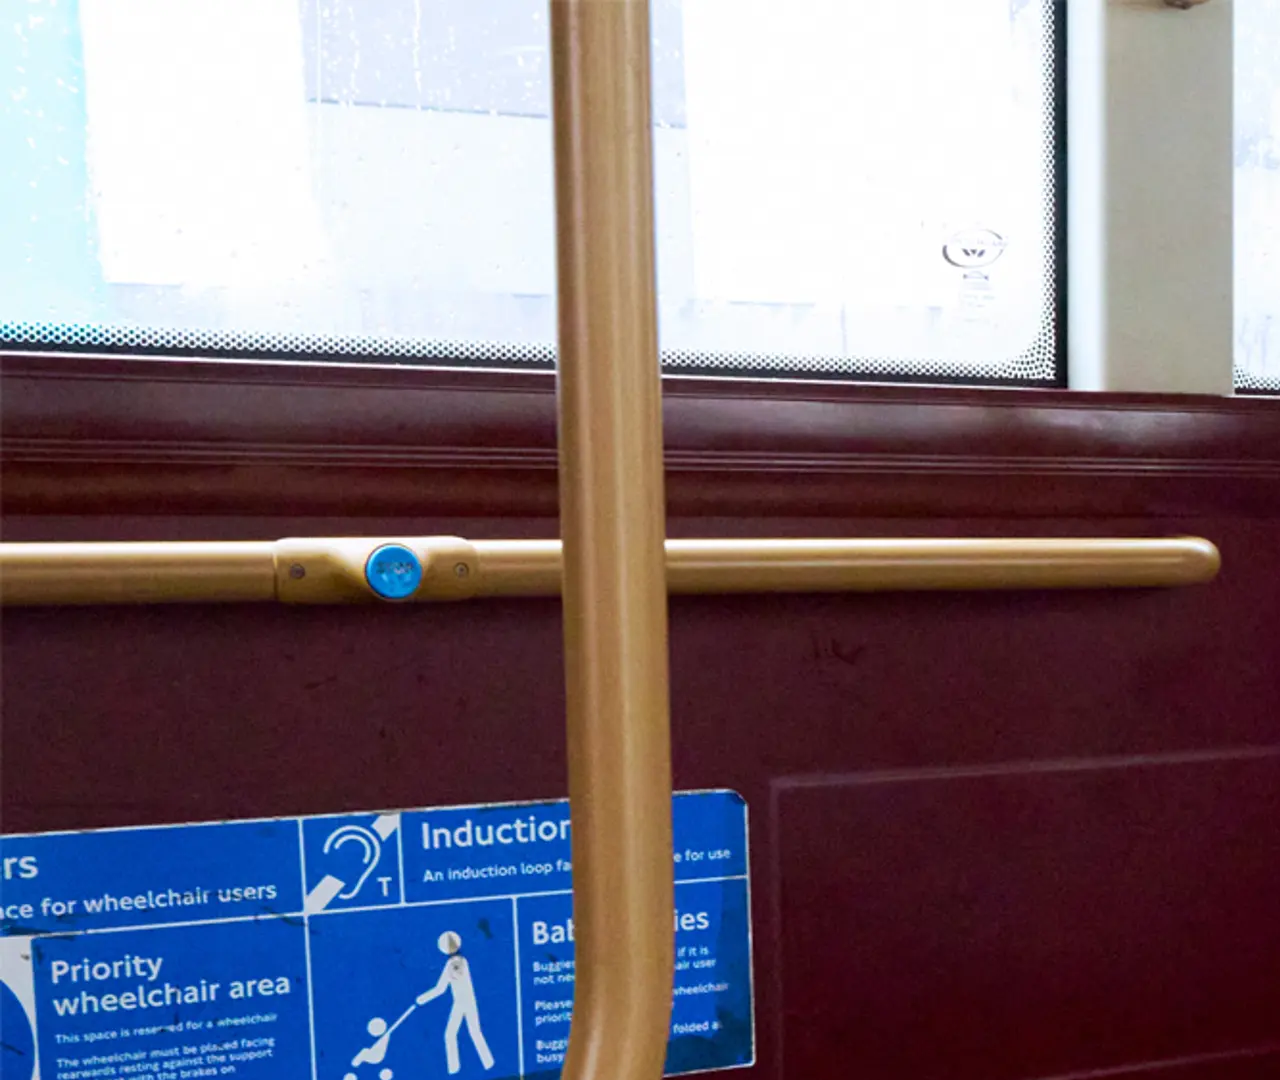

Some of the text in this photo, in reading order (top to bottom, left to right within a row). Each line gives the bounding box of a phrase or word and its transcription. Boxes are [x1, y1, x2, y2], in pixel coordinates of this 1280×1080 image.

[0, 855, 38, 880] rs
[423, 869, 444, 882] An
[448, 863, 517, 880] induction
[520, 859, 553, 876] loop
[555, 859, 572, 872] fa
[684, 848, 704, 861] for
[707, 848, 732, 861] use
[0, 884, 277, 919] ce for wheelchair users
[377, 876, 392, 897] T
[532, 908, 710, 945] Bab ies
[51, 955, 163, 984] Priority
[533, 974, 555, 986] not
[692, 958, 717, 969] user
[53, 976, 291, 1016] wheelchair area
[55, 1033, 80, 1044] This
[83, 1030, 117, 1043] space
[120, 1028, 130, 1037] is
[185, 1020, 203, 1030] for
[206, 1021, 213, 1029] a
[216, 1013, 277, 1027] wheelchair
[534, 1011, 573, 1027] priorit
[673, 1020, 710, 1034] folded
[57, 1057, 79, 1068] The
[82, 1050, 147, 1065] wheelchair
[150, 1047, 180, 1059] must
[182, 1045, 198, 1055] be
[241, 1036, 275, 1050] facing
[57, 1049, 273, 1080] rearwards resting against the support
[157, 1070, 178, 1080] the
[180, 1066, 218, 1079] brakes
[220, 1065, 236, 1075] on
